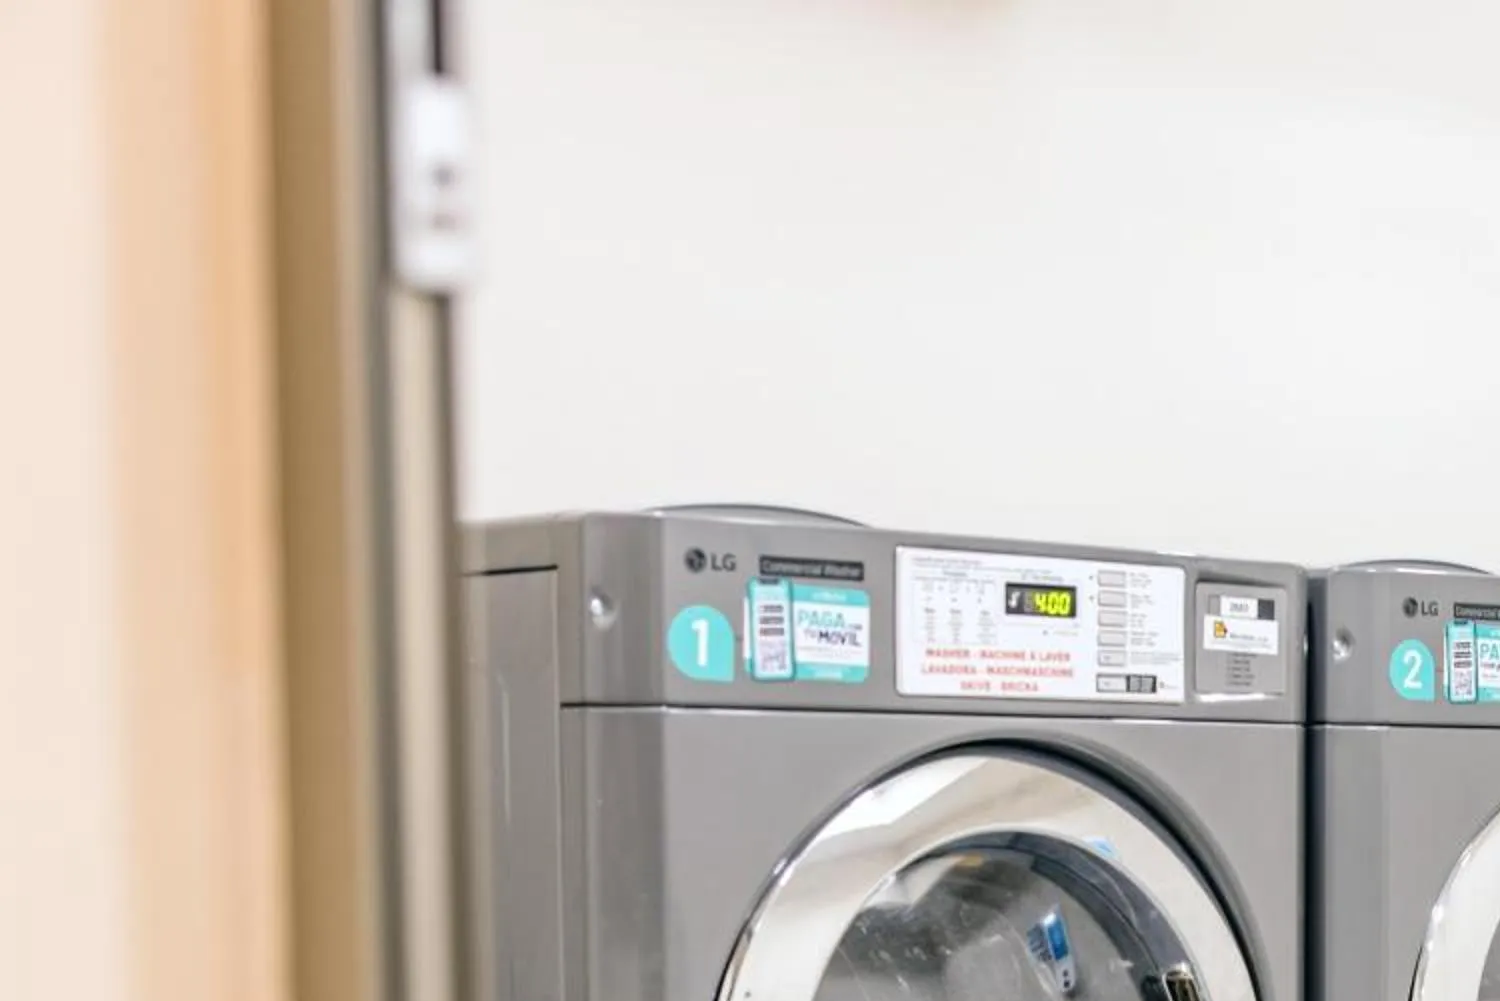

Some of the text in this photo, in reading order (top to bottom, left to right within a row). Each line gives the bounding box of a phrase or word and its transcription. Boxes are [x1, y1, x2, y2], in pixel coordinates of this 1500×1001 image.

[711, 553, 737, 572] LG
[1421, 601, 1439, 616] LG
[798, 609, 846, 629] PAGA
[691, 619, 709, 667] 1
[1403, 649, 1423, 689] 2
